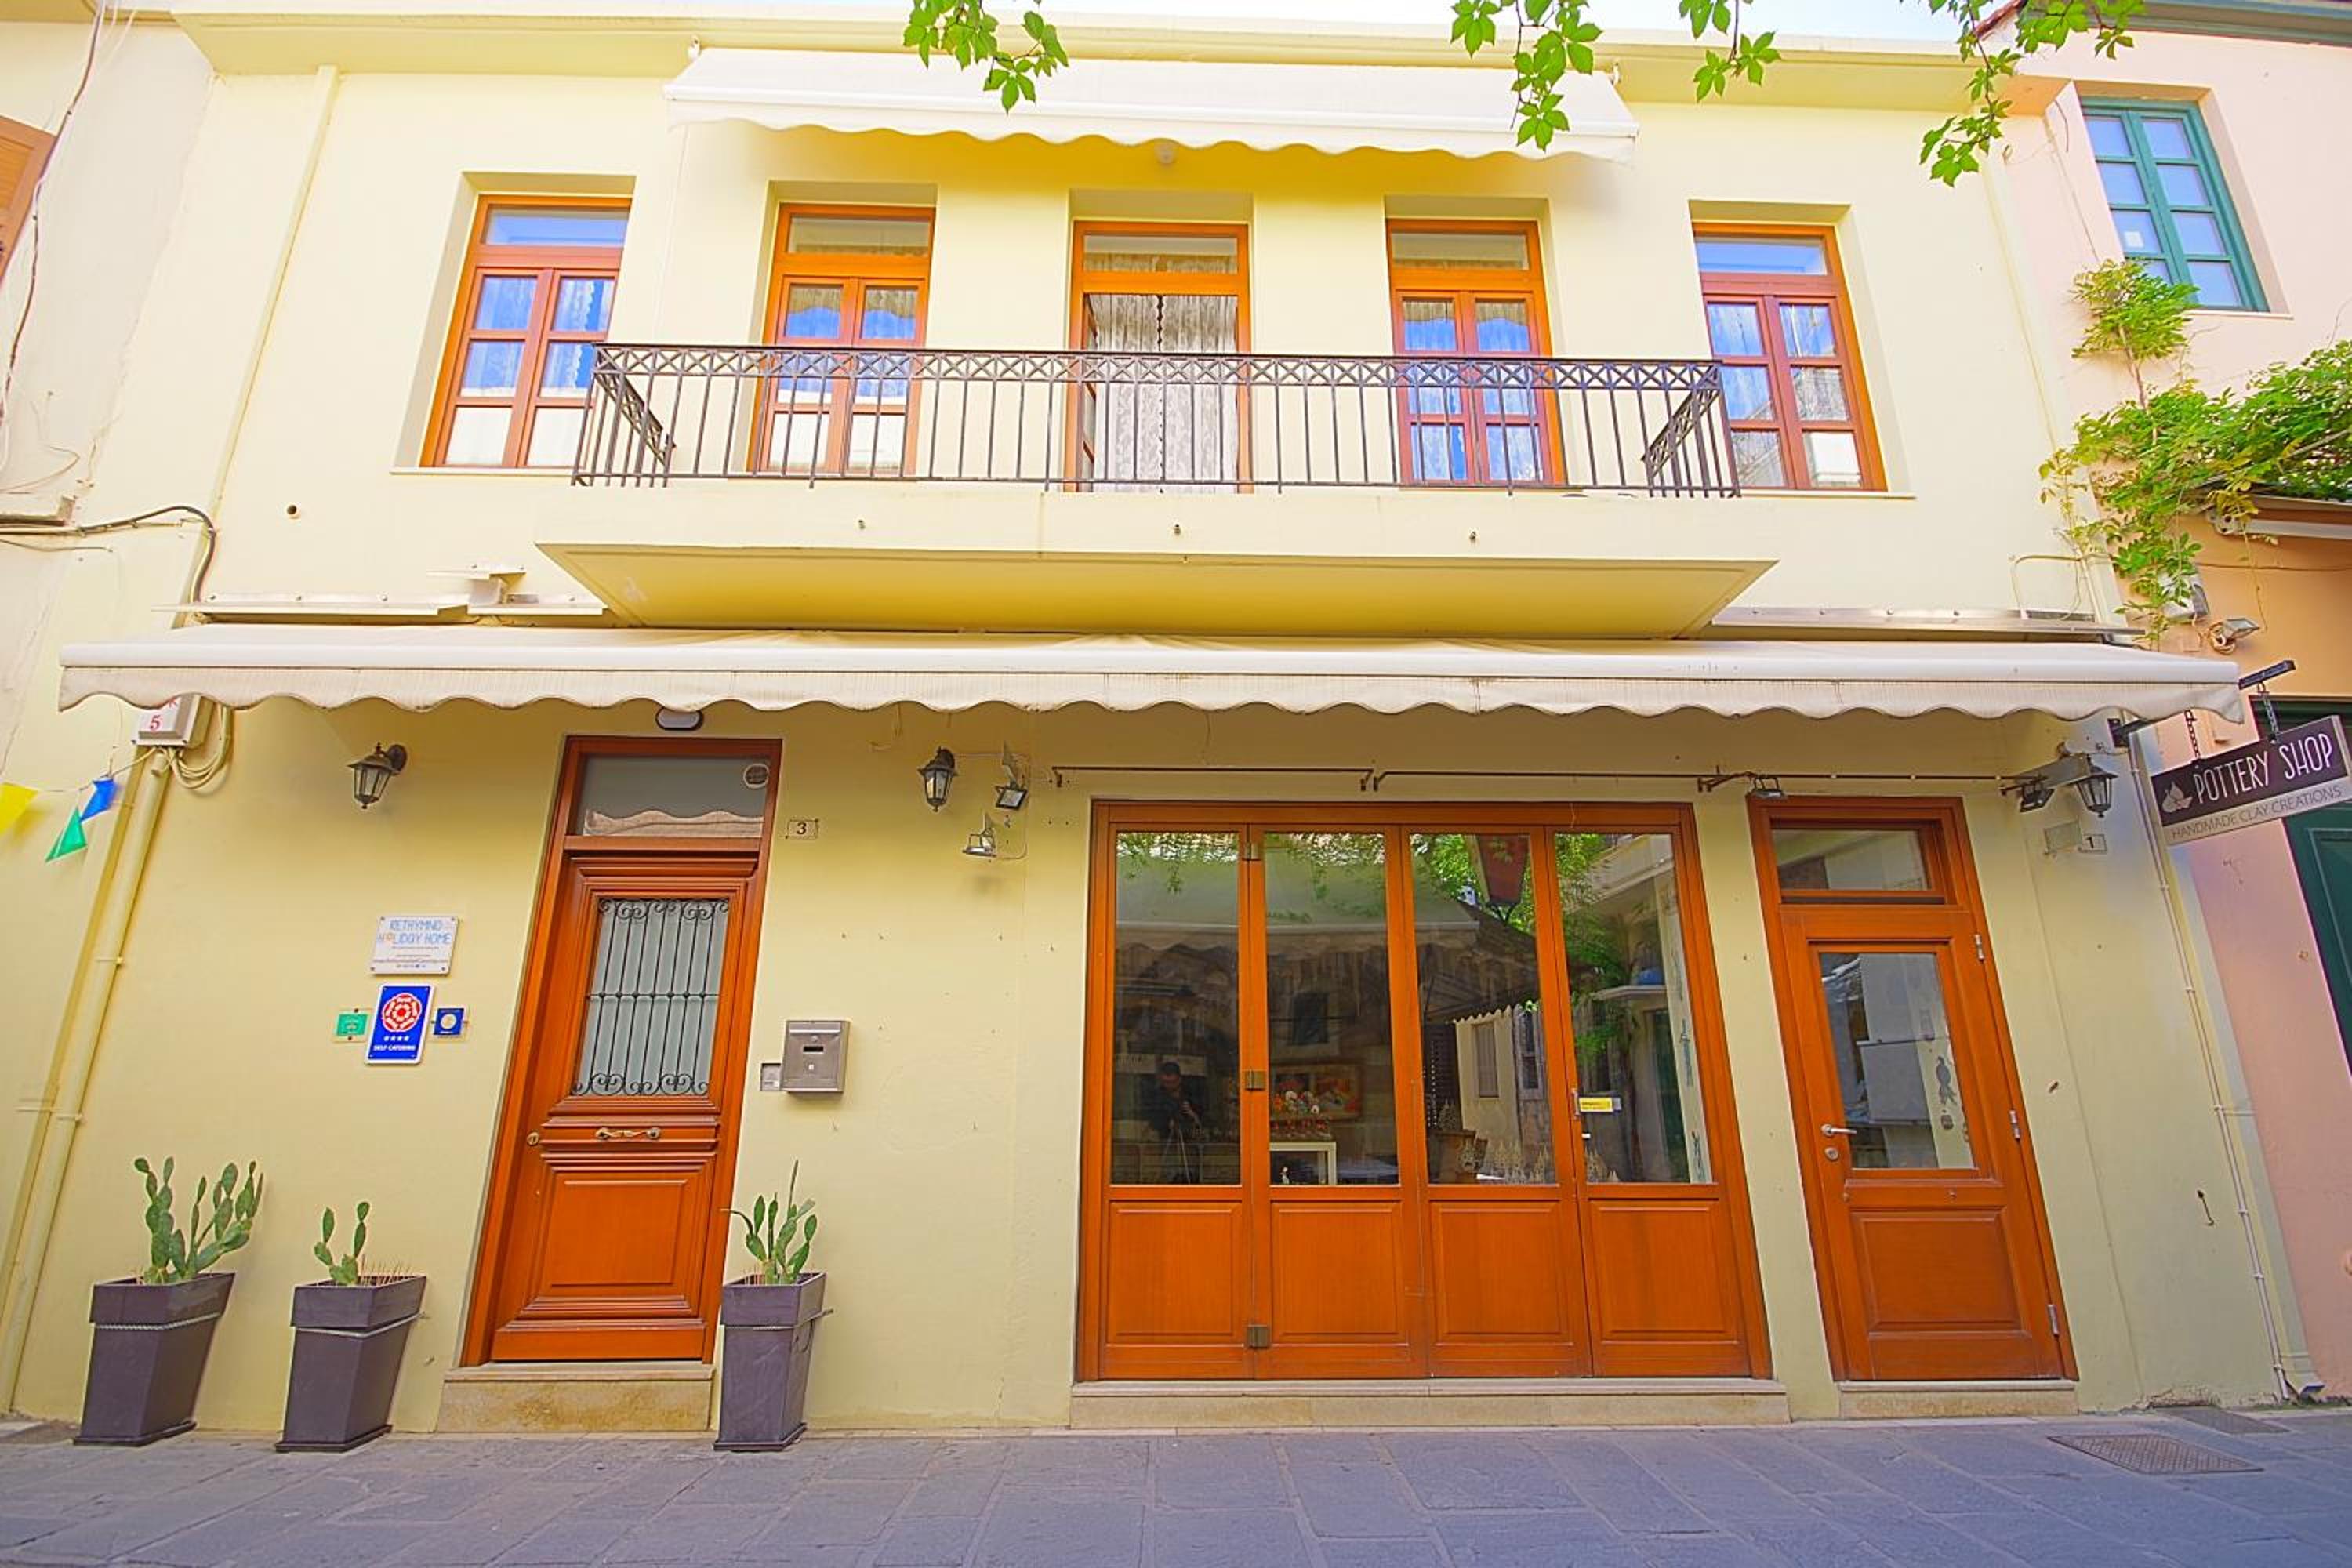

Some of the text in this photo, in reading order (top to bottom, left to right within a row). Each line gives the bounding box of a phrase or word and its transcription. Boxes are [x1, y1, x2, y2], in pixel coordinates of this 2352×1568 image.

[150, 714, 161, 731] 5
[2194, 733, 2332, 804] POTTERY SHOP
[2172, 786, 2342, 839] HANDMADE CLAY CREATIONS
[796, 822, 807, 835] 3
[2085, 836, 2094, 849] 1
